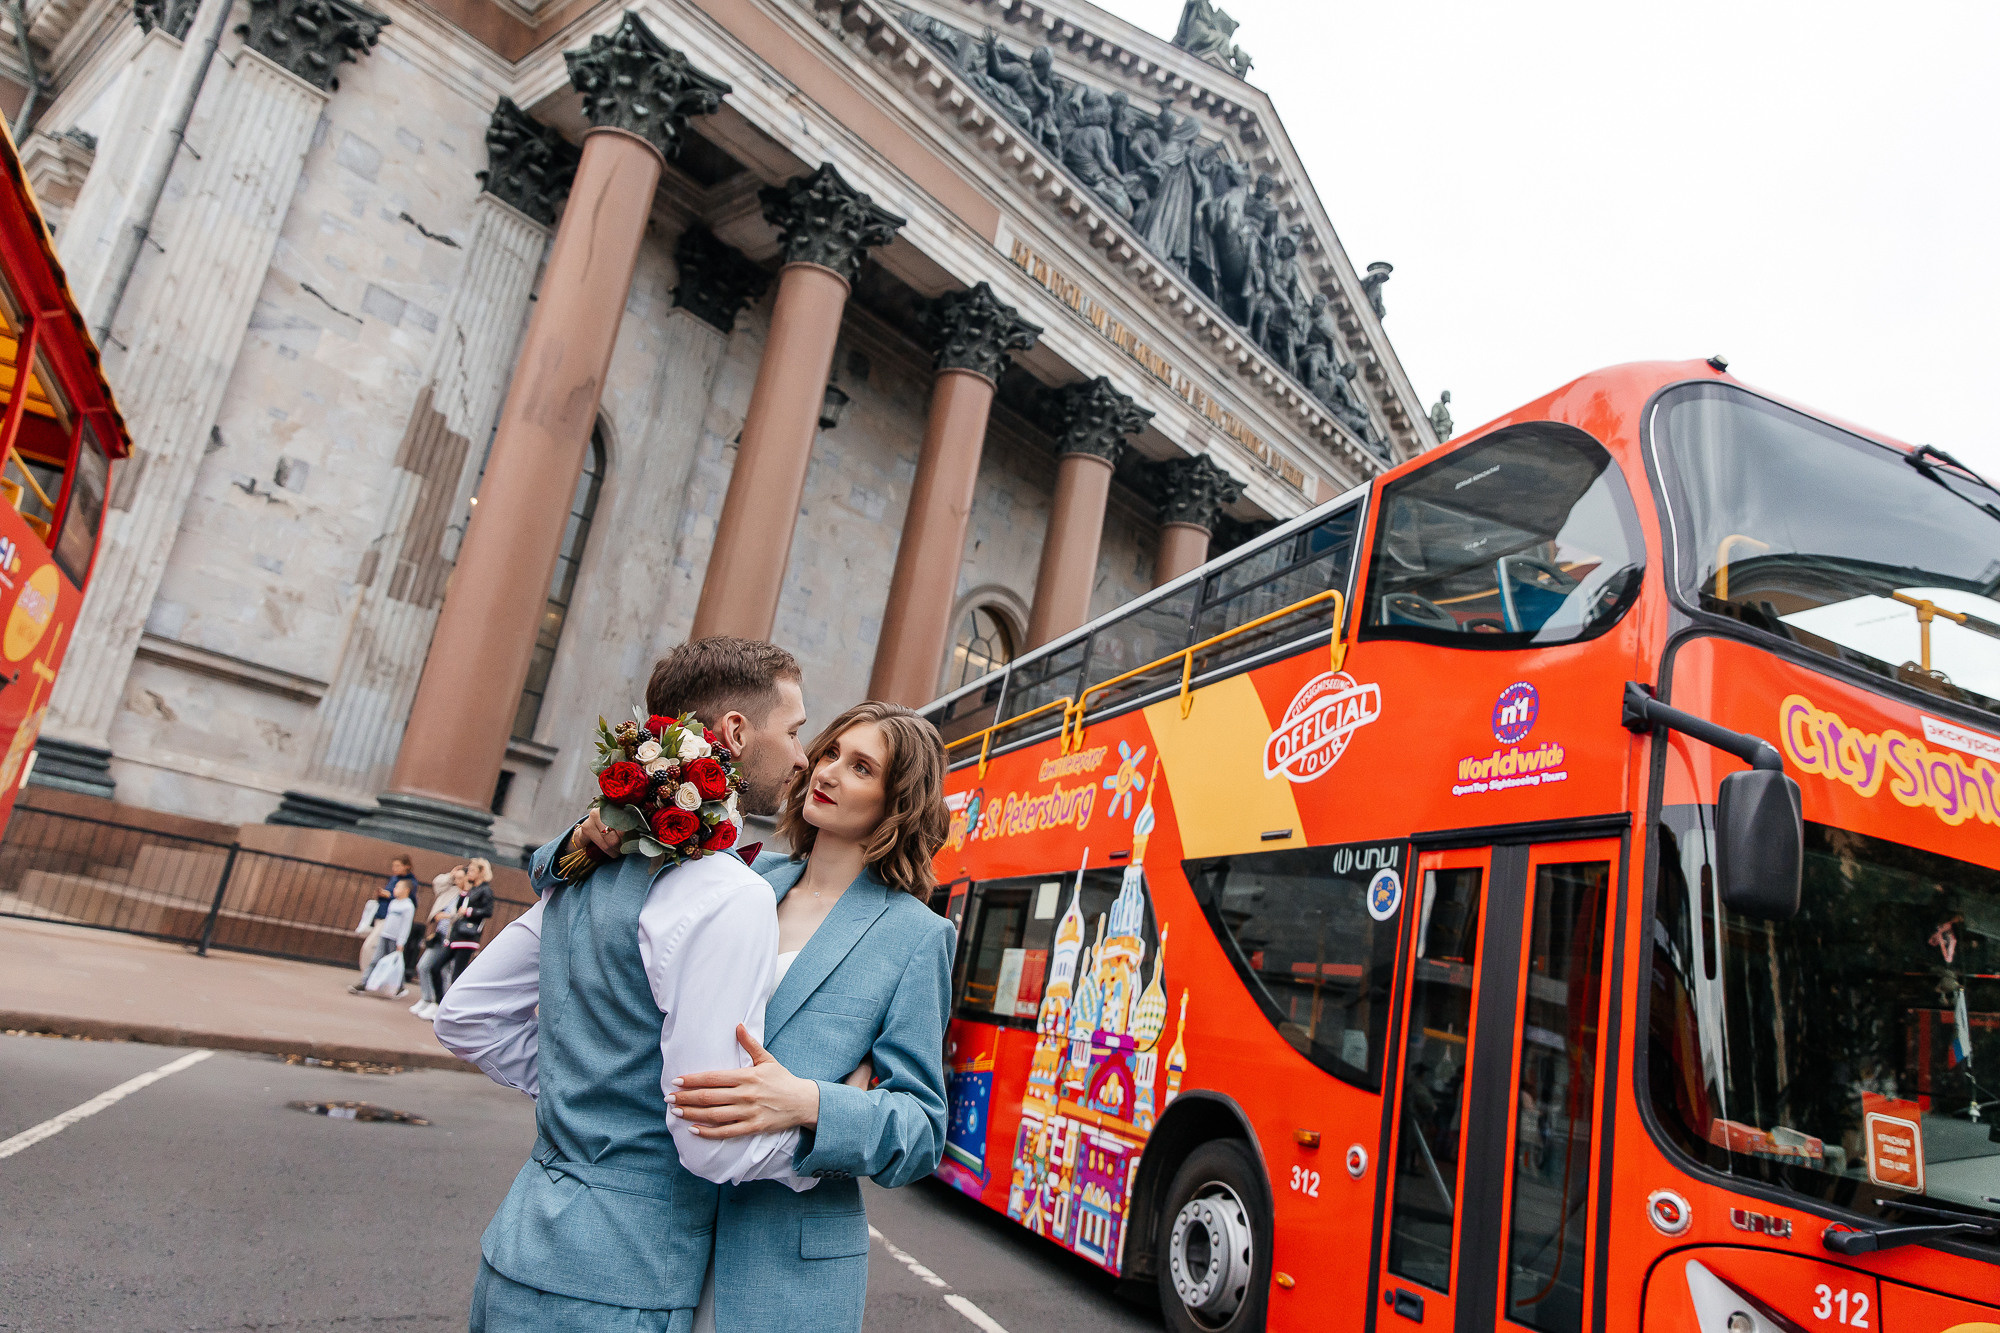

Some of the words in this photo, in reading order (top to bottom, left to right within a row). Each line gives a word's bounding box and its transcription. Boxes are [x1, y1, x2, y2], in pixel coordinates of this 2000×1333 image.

[1275, 692, 1373, 764] OFFICIAL
[1299, 736, 1344, 773] TOUR
[1459, 743, 1565, 780] Worldwide
[1541, 771, 1567, 783] Tours
[1290, 1165, 1321, 1198] 312
[1813, 1284, 1870, 1329] 312
